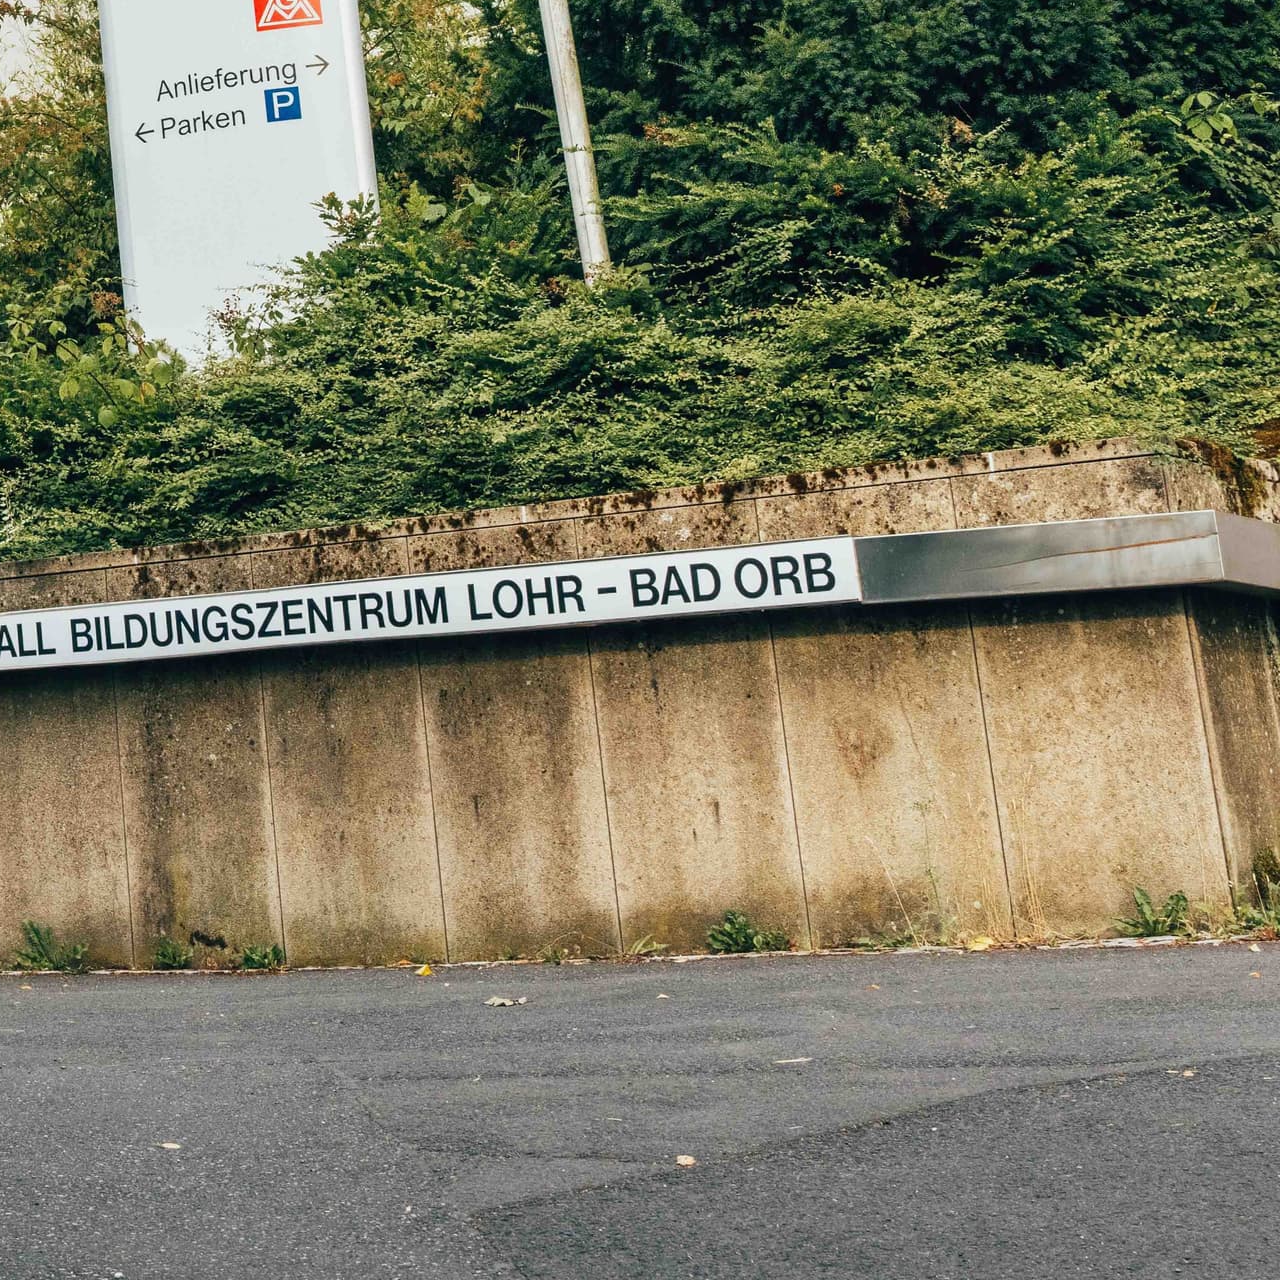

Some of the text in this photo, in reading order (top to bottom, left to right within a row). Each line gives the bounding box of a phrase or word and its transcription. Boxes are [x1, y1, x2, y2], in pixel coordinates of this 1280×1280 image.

[156, 62, 298, 102] Anlieferung
[160, 90, 295, 140] Parken P
[70, 586, 449, 653] BILDUNGSZENTRUM
[467, 574, 586, 621] LOHR
[629, 562, 721, 608] BAD
[734, 552, 836, 599] ORB
